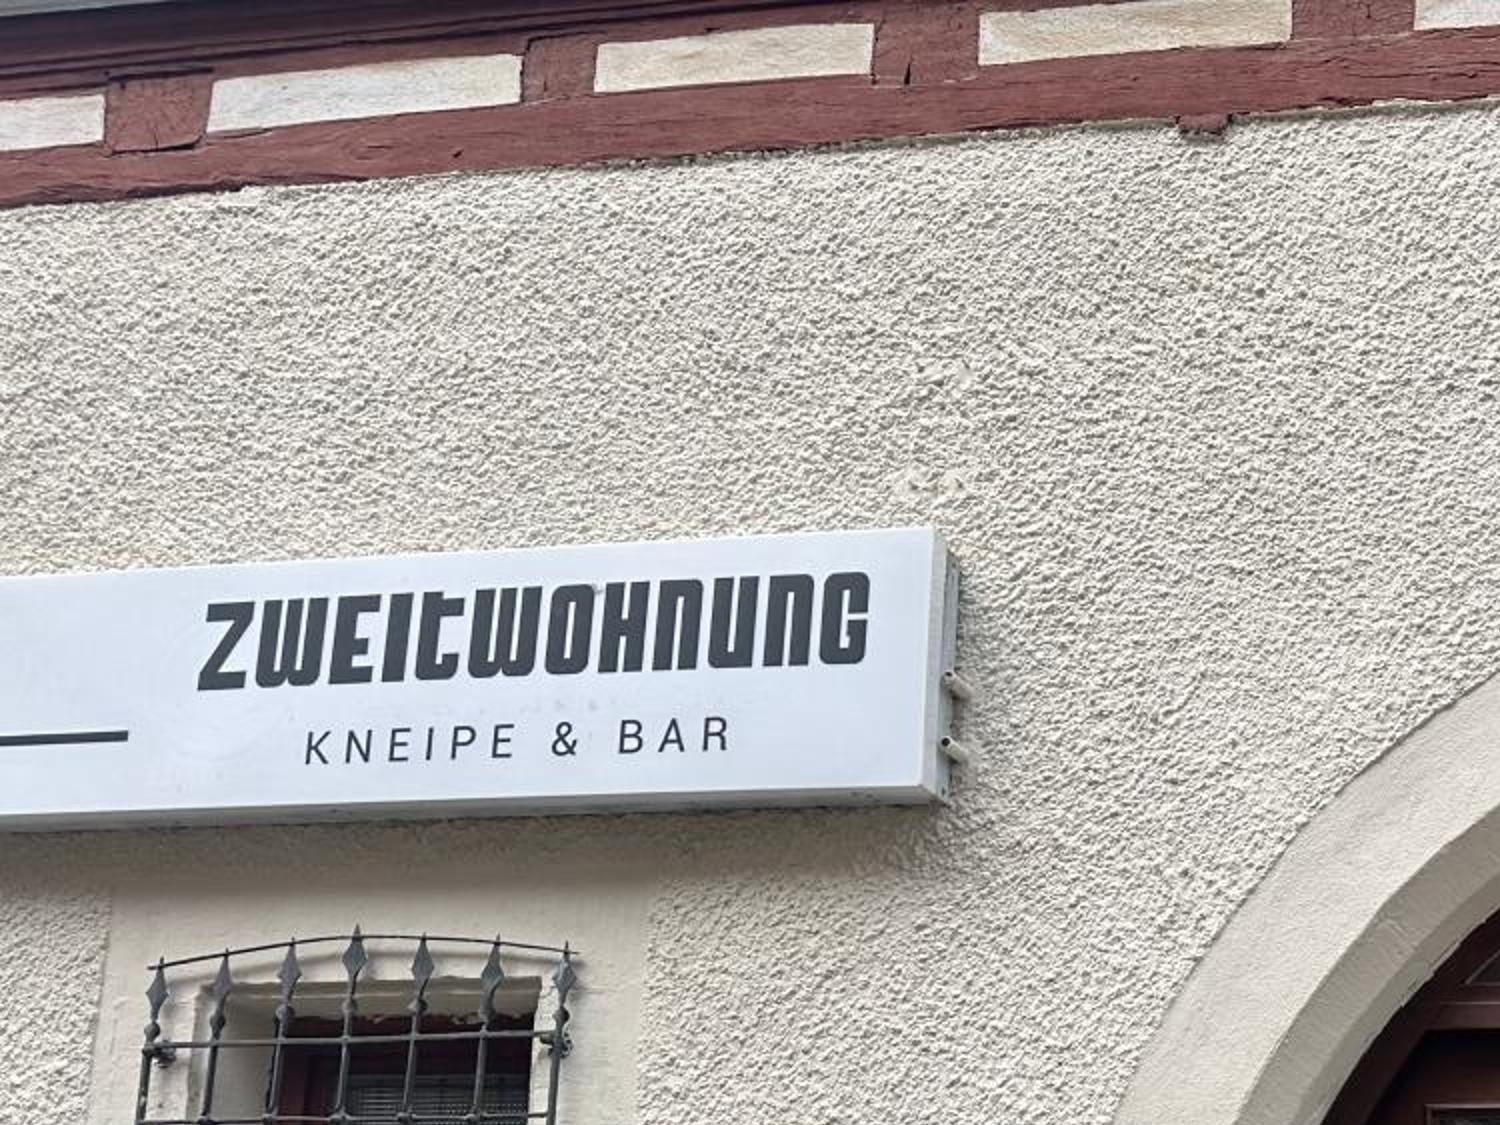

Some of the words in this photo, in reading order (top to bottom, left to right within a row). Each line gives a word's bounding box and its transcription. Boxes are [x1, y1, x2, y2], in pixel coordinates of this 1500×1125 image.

[305, 724, 514, 764] KNEIPE
[551, 719, 578, 757] &
[619, 716, 730, 755] BAR
